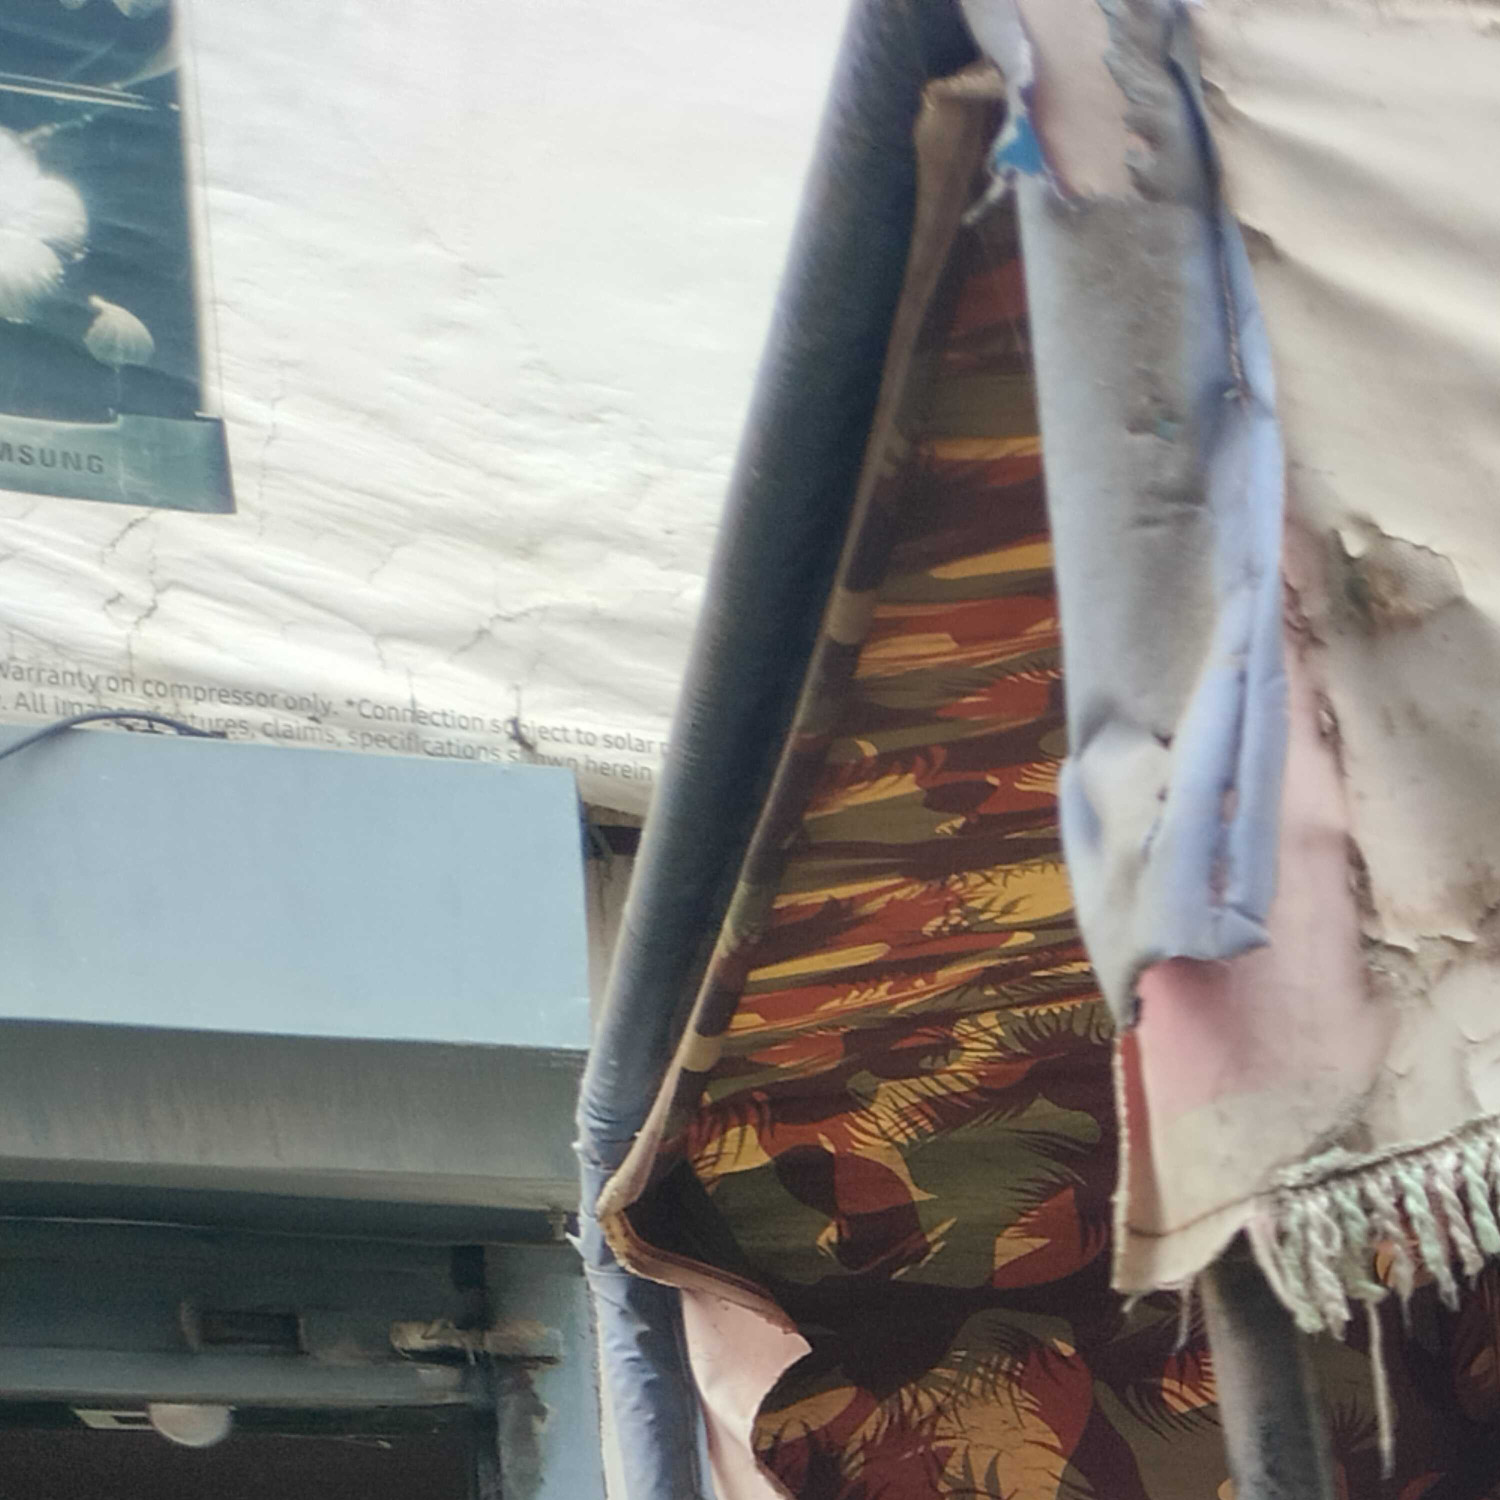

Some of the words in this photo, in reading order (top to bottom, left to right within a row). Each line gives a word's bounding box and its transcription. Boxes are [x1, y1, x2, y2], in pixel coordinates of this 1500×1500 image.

[14, 691, 48, 715] All
[348, 730, 501, 761] specifications
[508, 748, 579, 772] swn
[584, 754, 653, 781] herein
[106, 674, 136, 694] on
[142, 677, 278, 708] compressor
[284, 692, 339, 717] only.
[575, 727, 599, 747] to
[602, 732, 656, 753] solar
